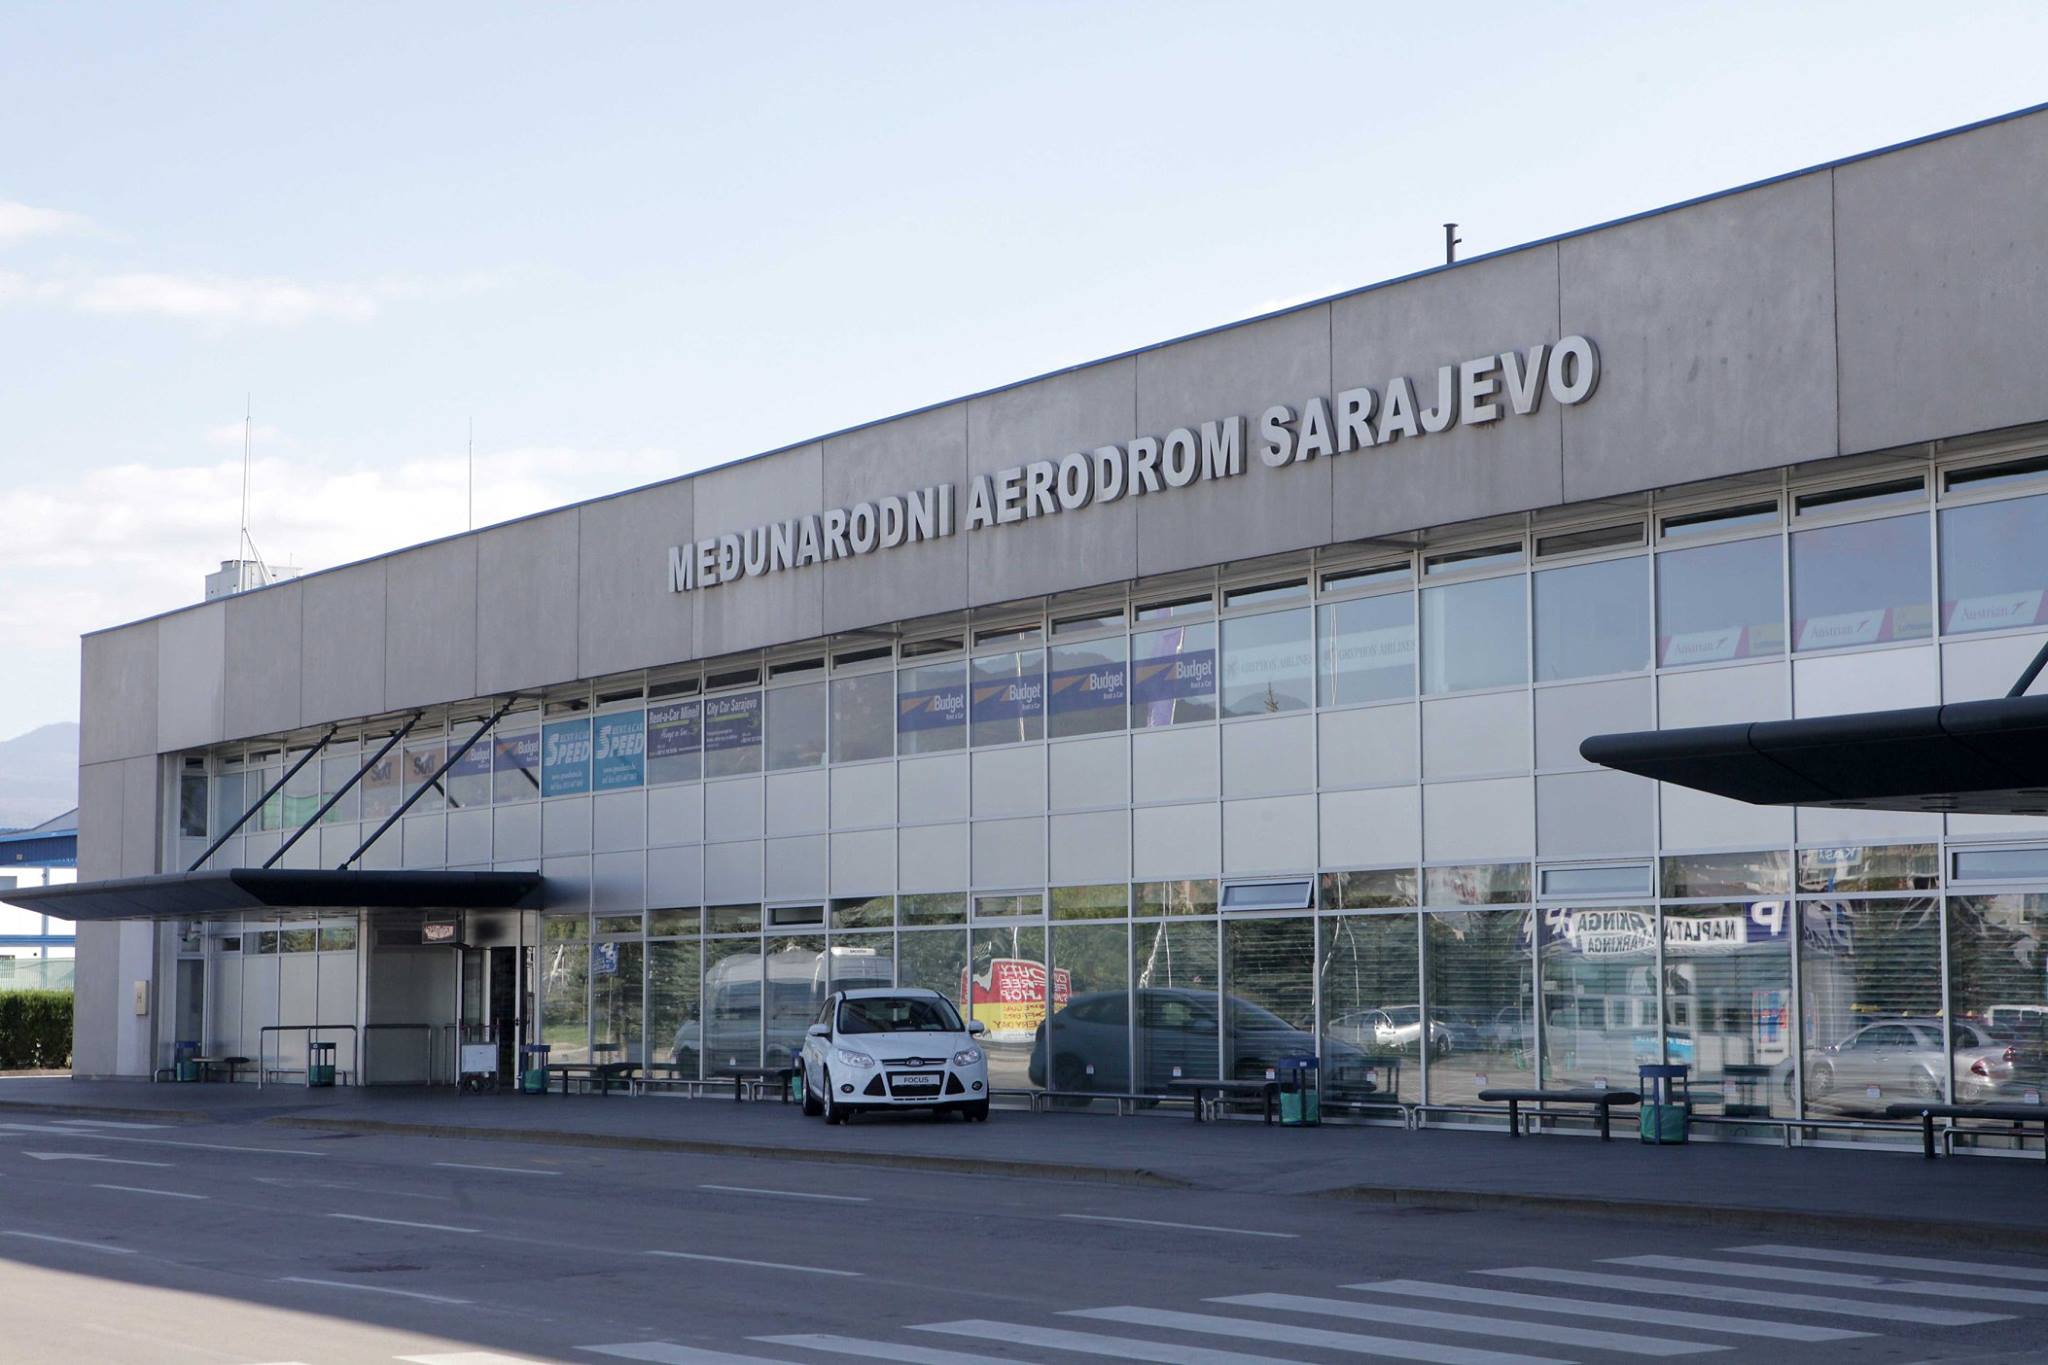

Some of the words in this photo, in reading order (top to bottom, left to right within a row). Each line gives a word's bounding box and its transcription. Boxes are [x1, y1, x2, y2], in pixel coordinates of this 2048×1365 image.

[668, 484, 954, 592] MEĐUNARODNI
[965, 416, 1247, 530] AERODROM
[1260, 335, 1599, 468] SARAJEVO
[1962, 607, 2008, 621] Austrian
[1176, 659, 1212, 680] Budget
[1089, 671, 1123, 692] Budget
[934, 693, 964, 713] Budget
[1009, 683, 1040, 703] Budget
[707, 702, 719, 716] City
[720, 701, 730, 713] Car
[731, 697, 757, 712] Sarajevo
[518, 740, 538, 755] Budget
[544, 733, 590, 766] SPEED
[595, 725, 644, 759] SPEED
[904, 1076, 929, 1084] FOCUS
